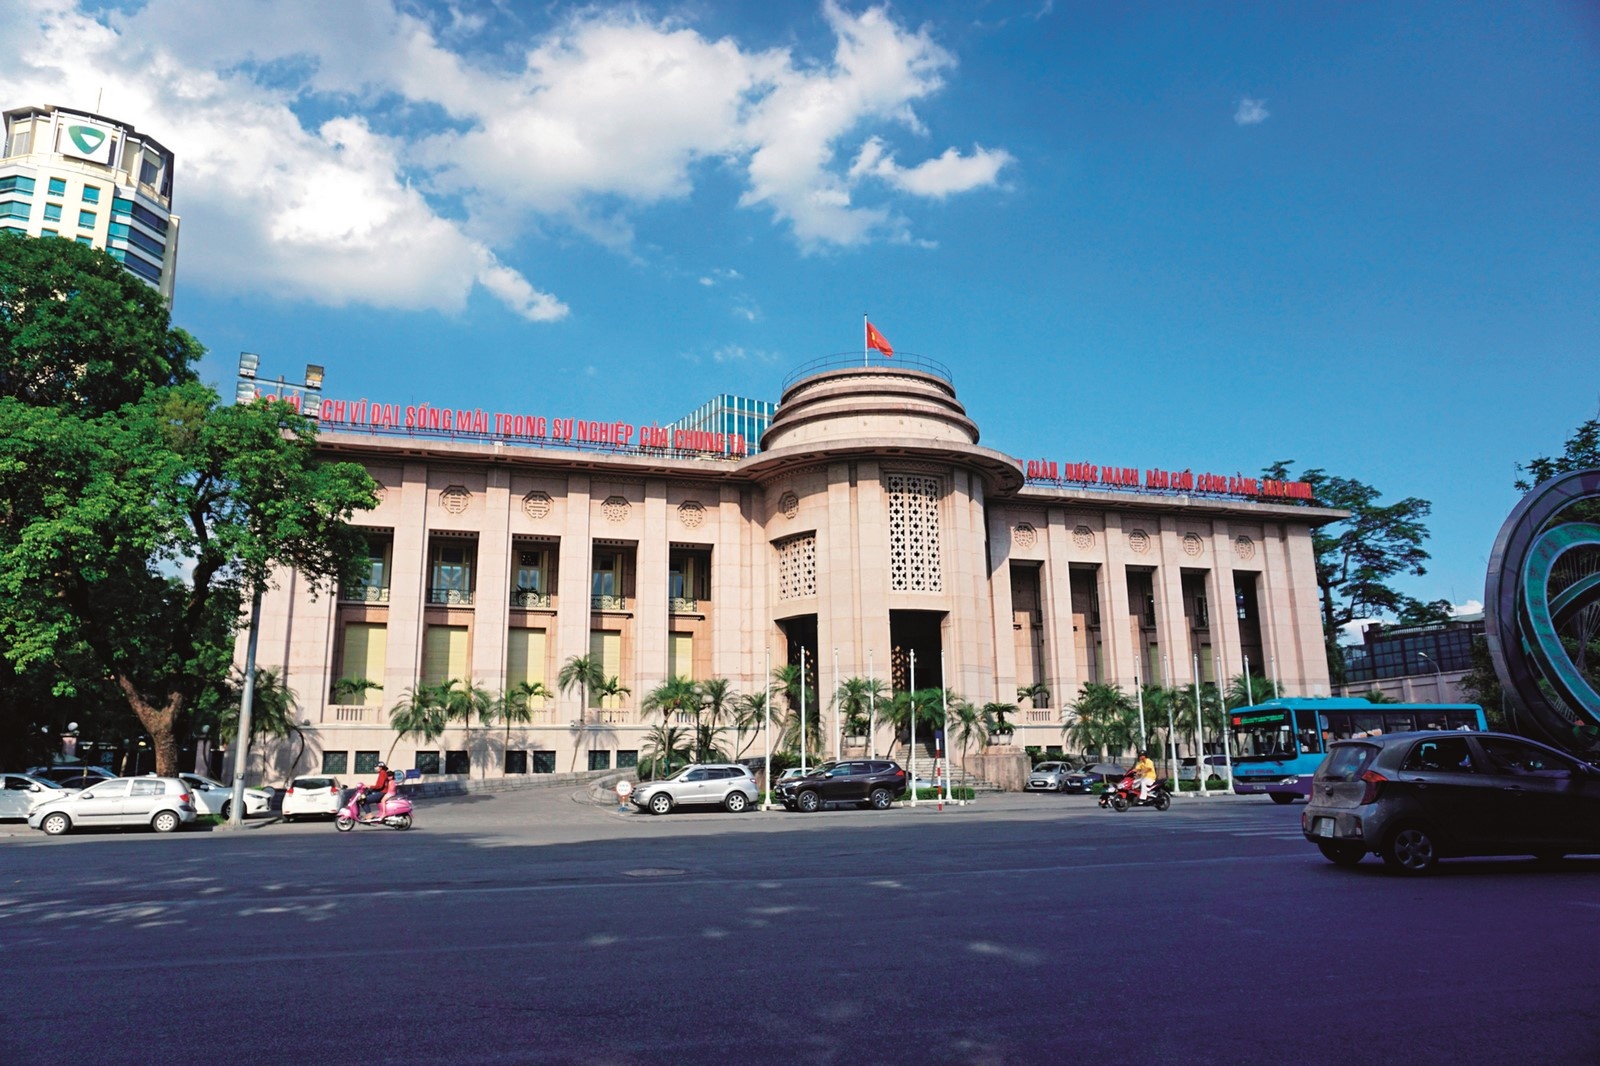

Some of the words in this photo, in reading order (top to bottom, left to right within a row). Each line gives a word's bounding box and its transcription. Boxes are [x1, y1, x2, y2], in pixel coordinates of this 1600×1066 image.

[351, 397, 367, 425] VĨ
[406, 402, 452, 430] SỐNG
[456, 408, 489, 434] MÃI
[495, 413, 546, 438] TRONG
[553, 417, 574, 443] SỰ
[577, 420, 634, 448] NGHIỆP
[640, 421, 669, 448] CỦA
[728, 434, 746, 454] TA
